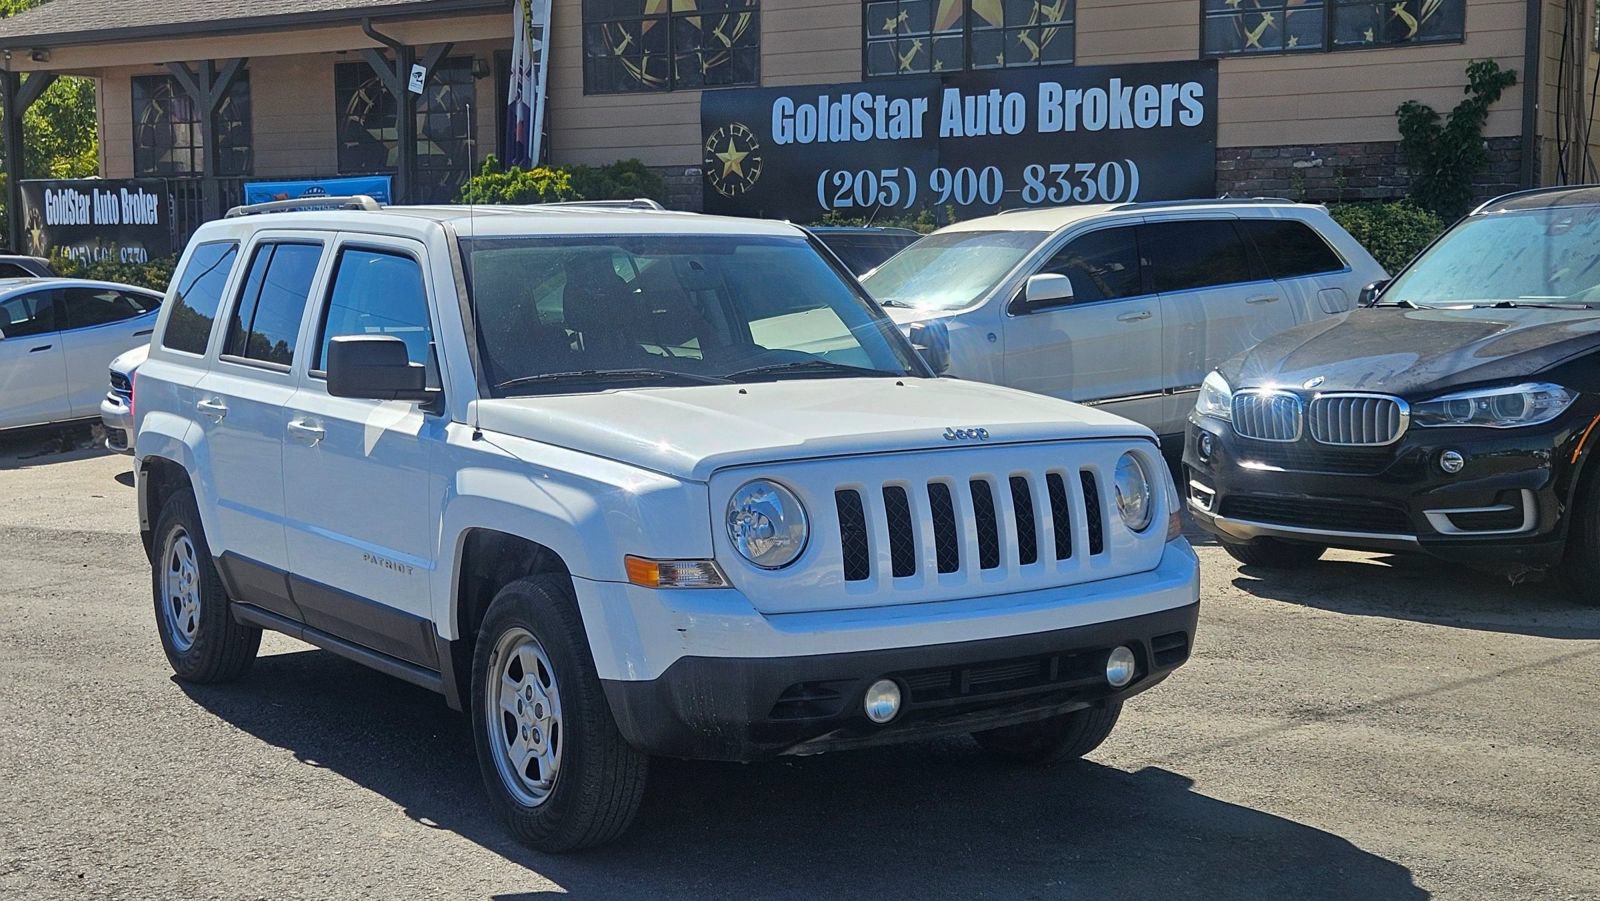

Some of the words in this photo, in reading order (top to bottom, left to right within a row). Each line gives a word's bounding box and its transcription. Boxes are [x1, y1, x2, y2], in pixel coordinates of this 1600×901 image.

[772, 92, 928, 145] GoldStar
[939, 87, 1026, 138] Auto
[1038, 78, 1204, 133] Brokers
[45, 188, 90, 225] GoldStar
[93, 188, 119, 225] Auto
[120, 187, 158, 225] Broker
[817, 167, 917, 211] (205)
[943, 427, 989, 440] Jeep
[363, 552, 414, 575] PATRIOT
